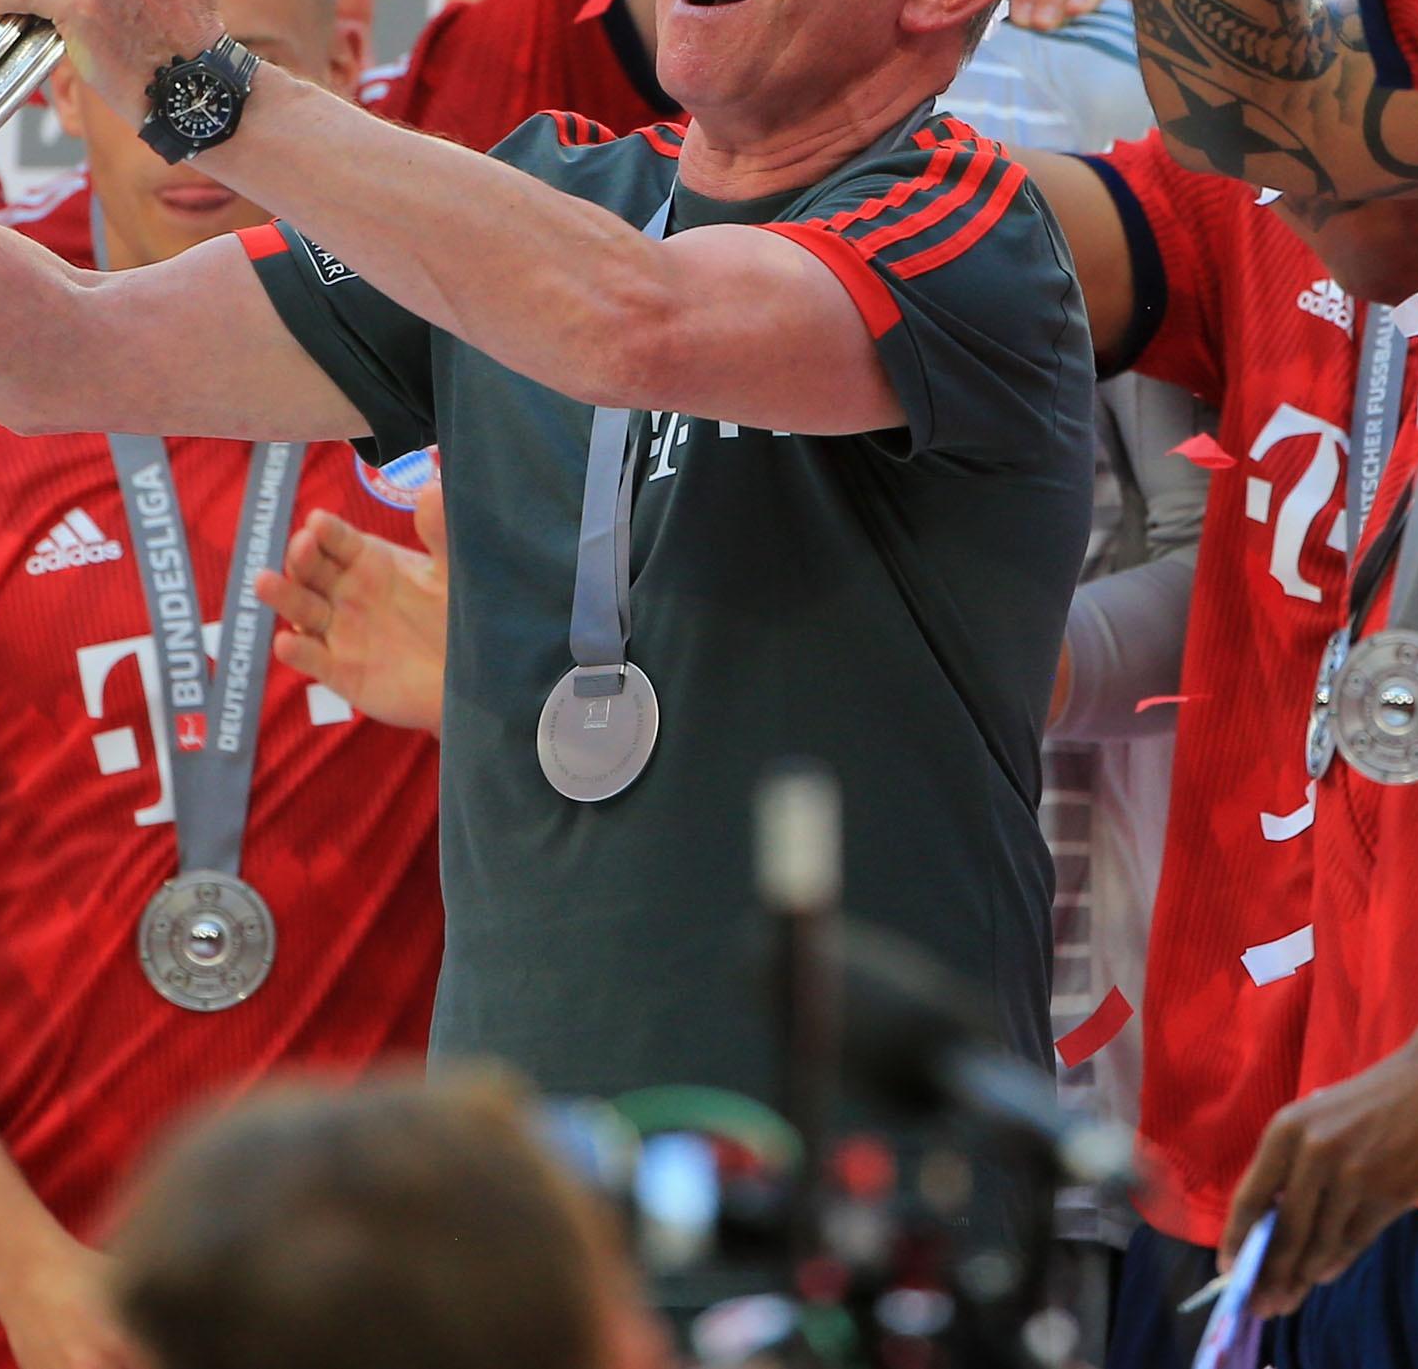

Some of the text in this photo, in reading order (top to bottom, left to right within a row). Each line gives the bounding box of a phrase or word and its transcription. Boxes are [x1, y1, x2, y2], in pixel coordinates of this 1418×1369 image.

[25, 540, 124, 576] adidas
[133, 464, 204, 707] BUNDESLIGA
[218, 611, 258, 753] DEUTSCHER
